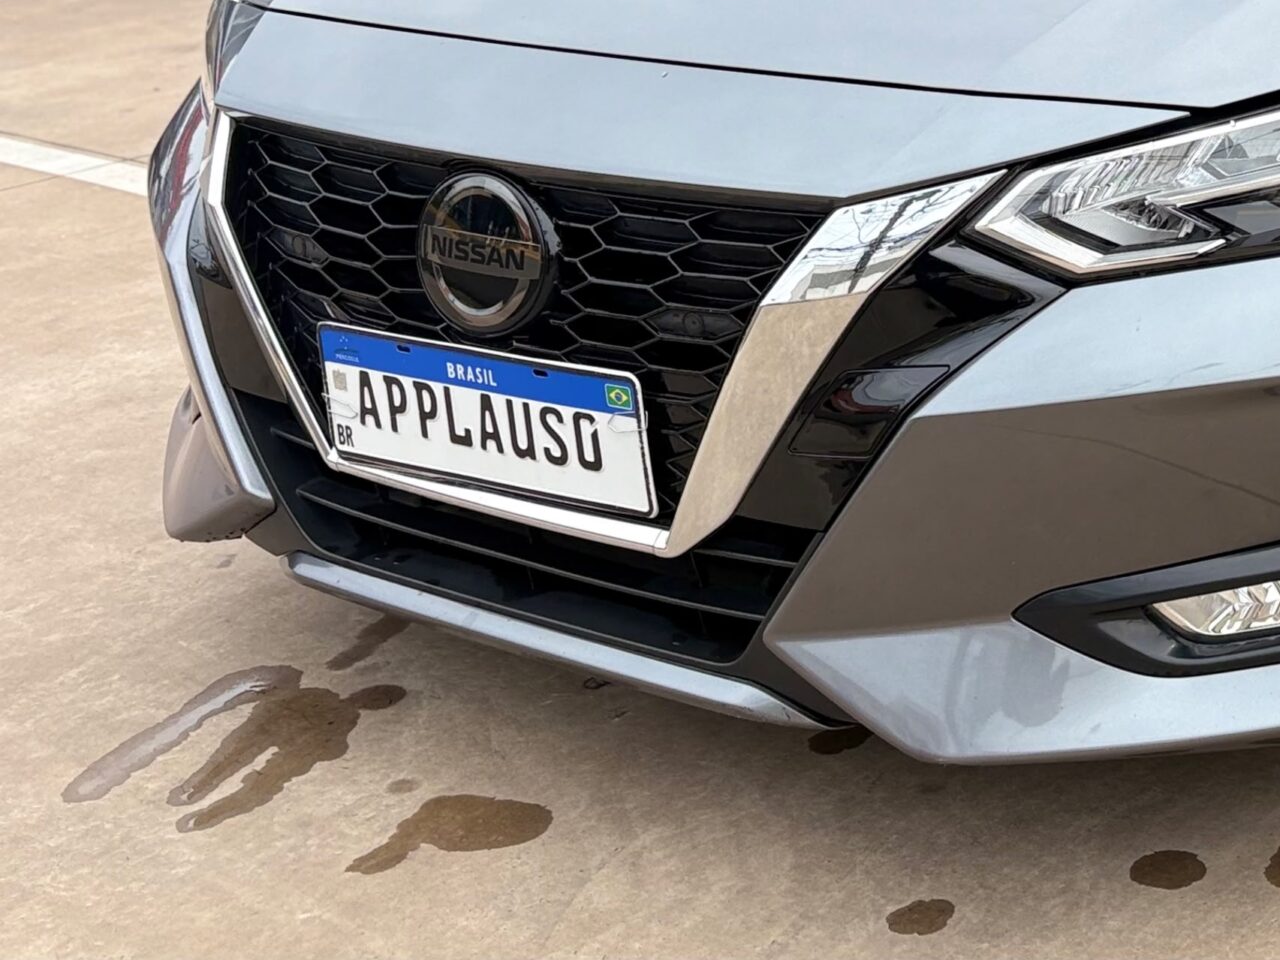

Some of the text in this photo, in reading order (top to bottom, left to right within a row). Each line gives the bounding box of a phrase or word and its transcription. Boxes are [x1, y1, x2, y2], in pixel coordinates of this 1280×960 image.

[431, 234, 525, 271] NISSAN
[446, 361, 497, 387] BRASIL
[336, 423, 355, 448] BR
[359, 369, 604, 472] APPLAUSO
